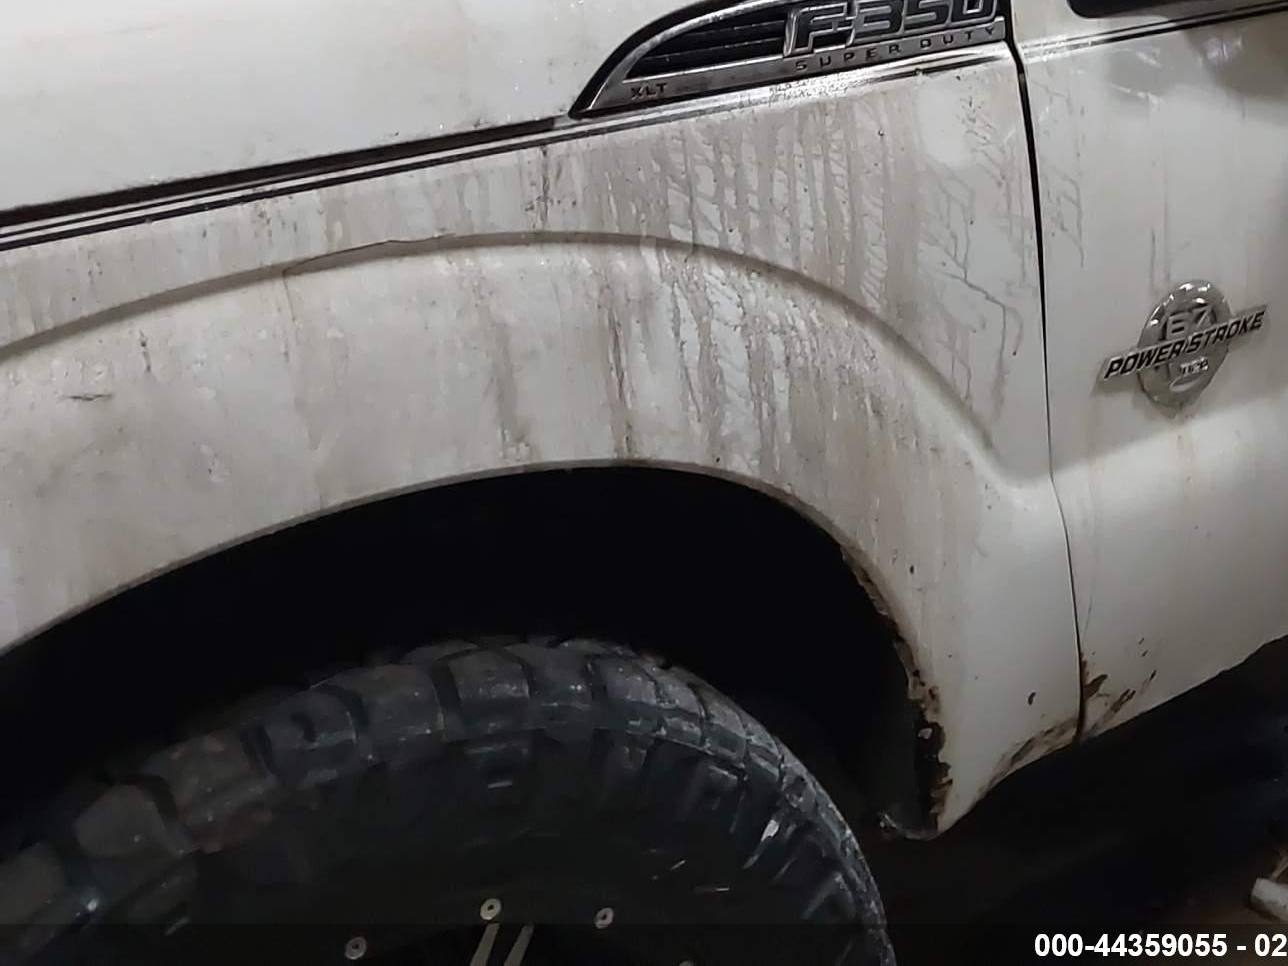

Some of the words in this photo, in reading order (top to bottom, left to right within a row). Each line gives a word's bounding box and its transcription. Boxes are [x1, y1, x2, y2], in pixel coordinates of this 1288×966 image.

[794, 43, 900, 71] SUPER
[920, 26, 996, 49] DUTY
[630, 81, 668, 98] XLT
